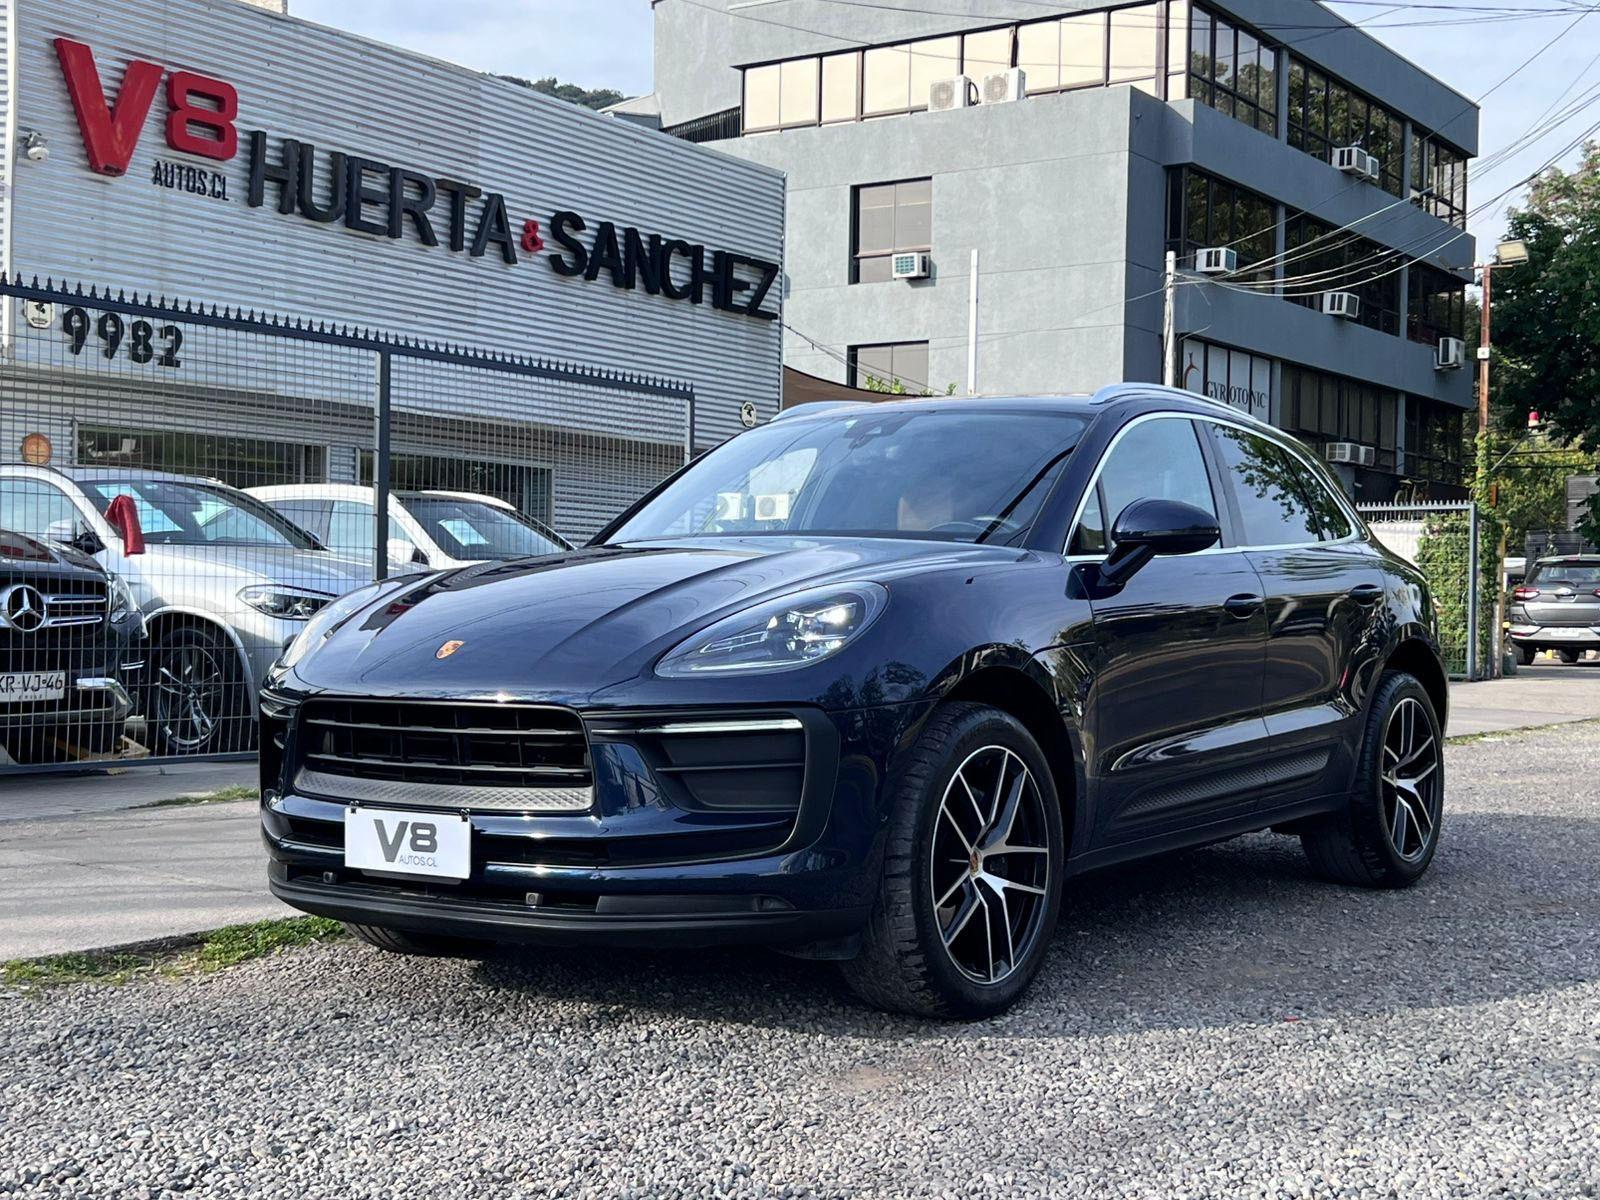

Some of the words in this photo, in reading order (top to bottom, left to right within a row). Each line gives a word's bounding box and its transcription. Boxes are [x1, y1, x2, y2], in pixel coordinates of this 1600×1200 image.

[54, 38, 238, 177] V8
[153, 161, 230, 201] AUTOS.CL
[248, 130, 518, 265] HUERTA
[521, 220, 544, 252] &
[549, 211, 779, 320] SANCHEZ
[63, 307, 183, 368] 9982
[1207, 381, 1266, 408] GYROTONIC
[373, 819, 438, 862] V8
[399, 855, 438, 867] AUTOS.CL
